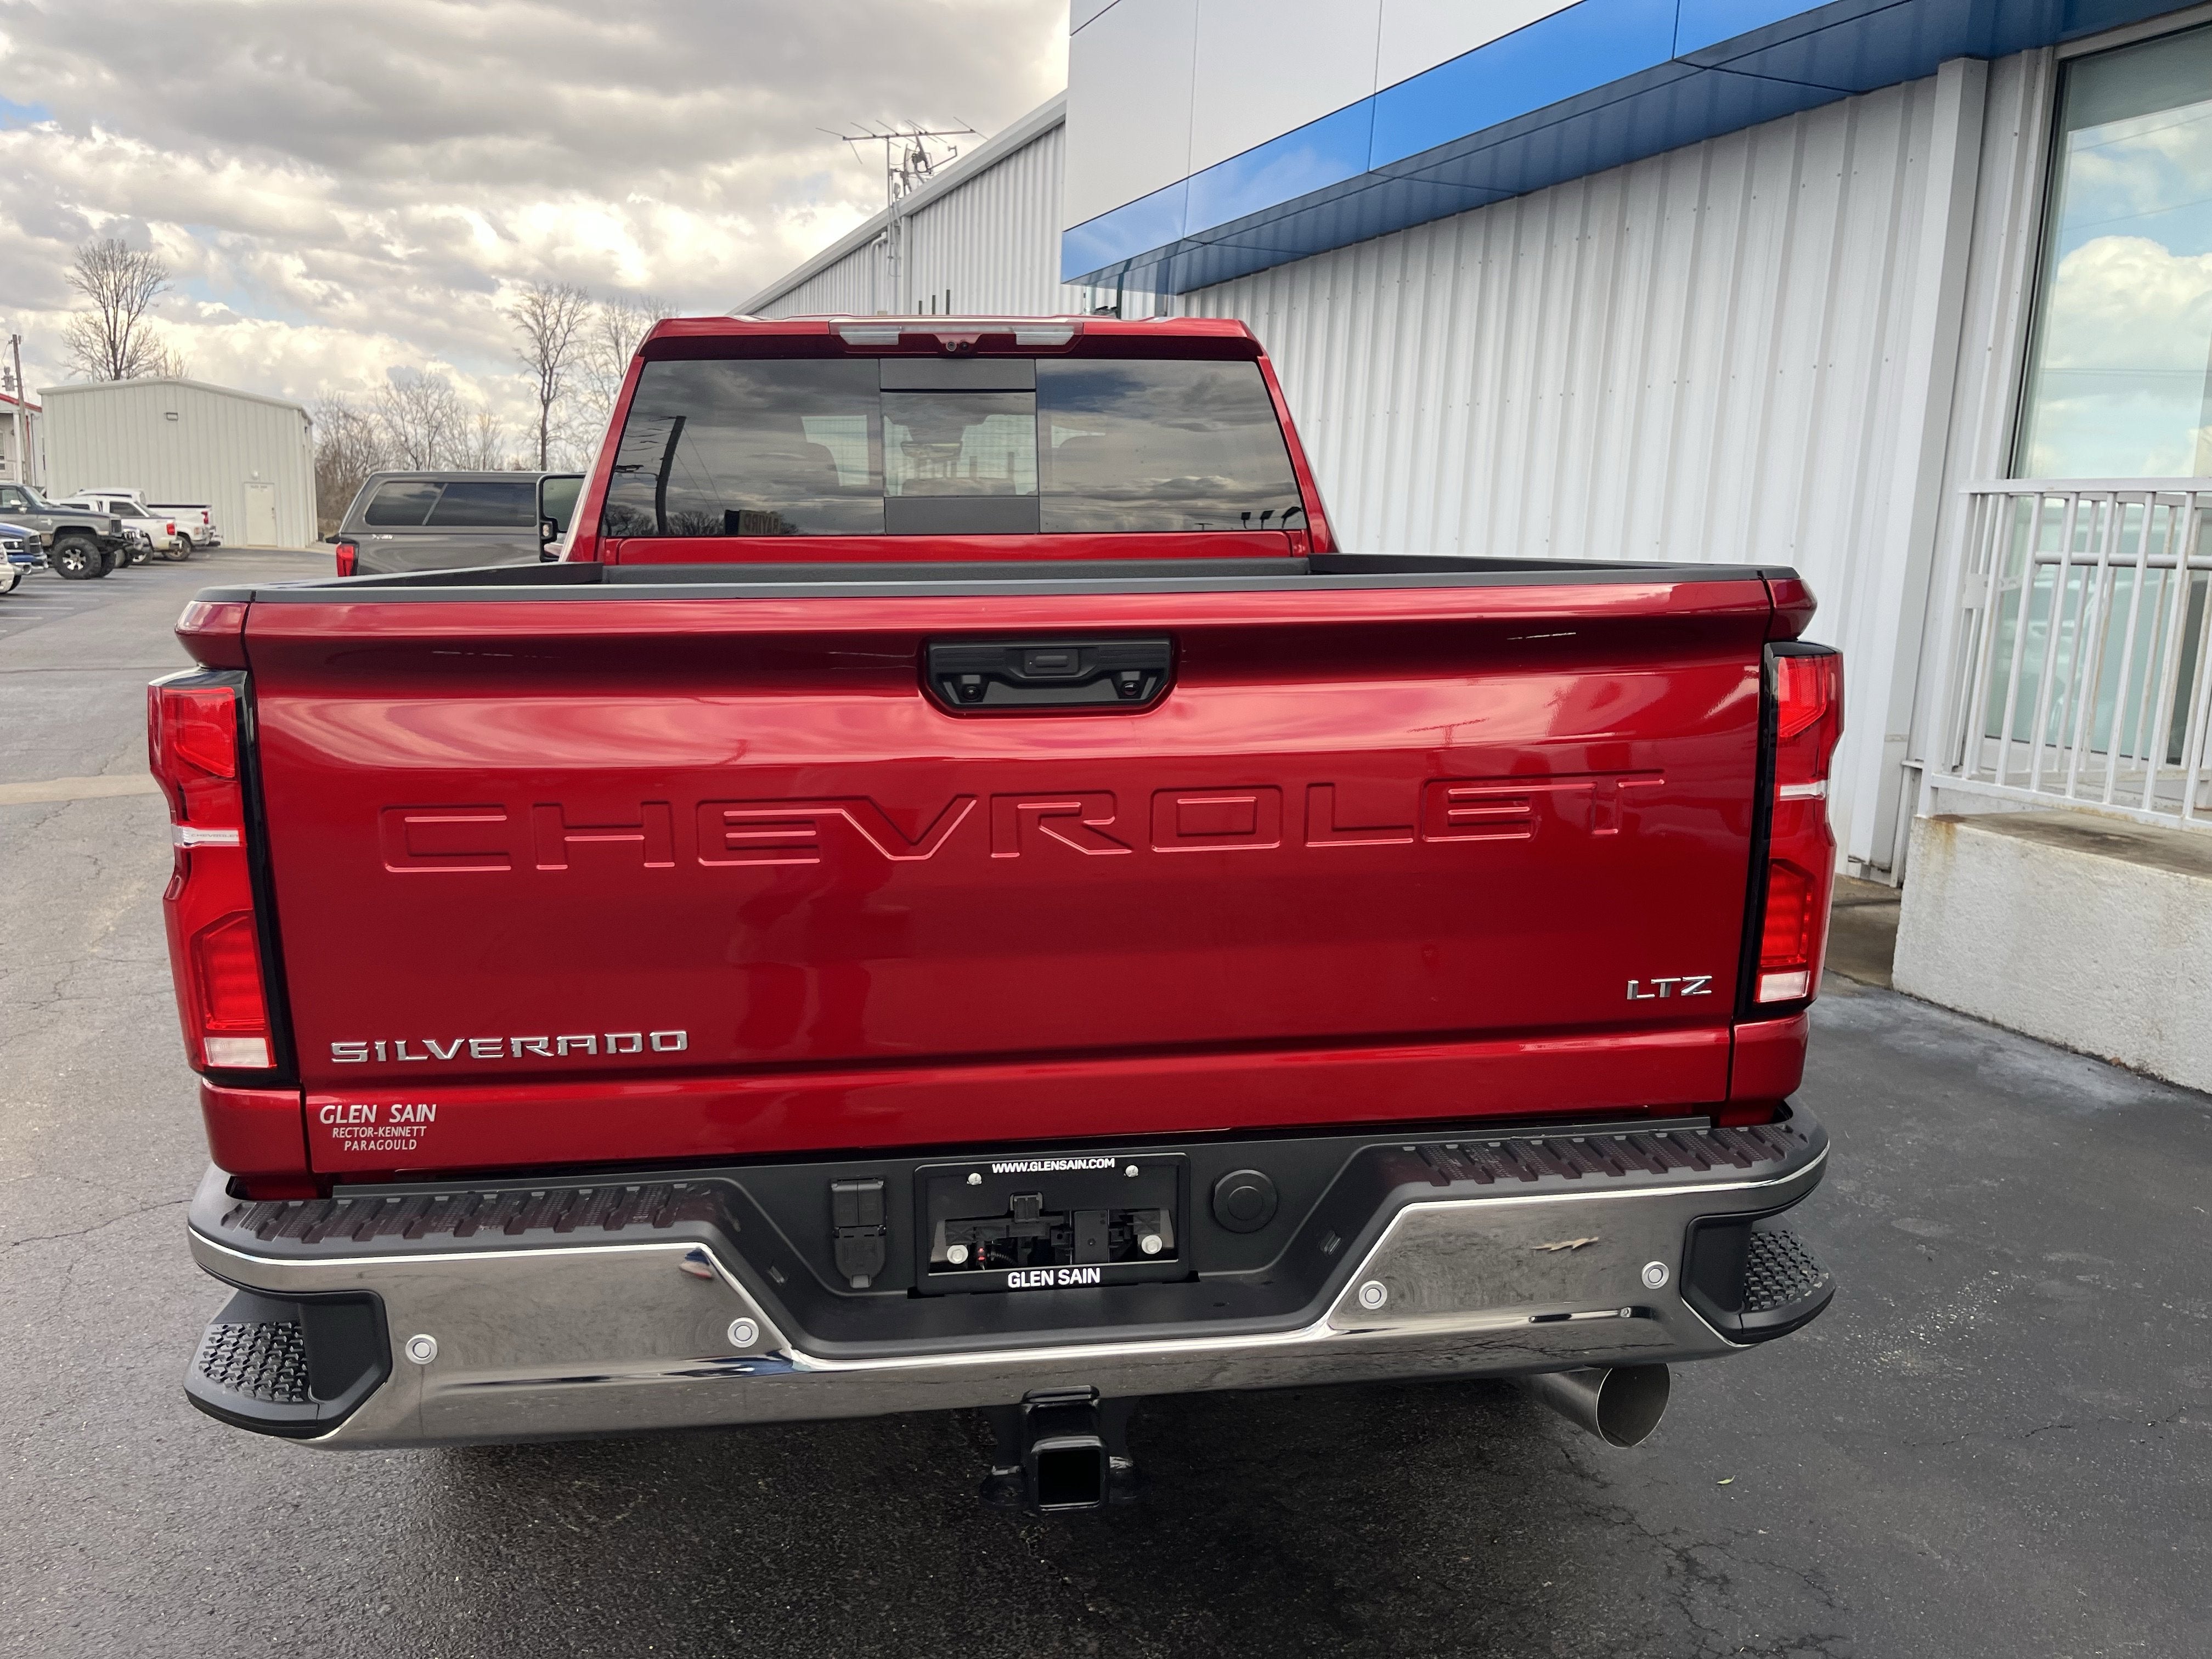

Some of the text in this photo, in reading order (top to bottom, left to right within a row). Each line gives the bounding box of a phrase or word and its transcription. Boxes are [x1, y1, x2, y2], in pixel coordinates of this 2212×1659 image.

[381, 770, 1664, 873] CHEVROLET
[1627, 975, 1713, 1000] LTZ
[331, 1030, 687, 1063] SILVERADO
[319, 1103, 437, 1124] GLEN SAIN
[332, 1125, 427, 1138] RECTOR-KENNETT
[344, 1138, 417, 1151] PARAGOULD
[992, 1158, 1115, 1173] WWW.GLENSAIN.COM
[1007, 1267, 1101, 1288] GLEN SAIN
